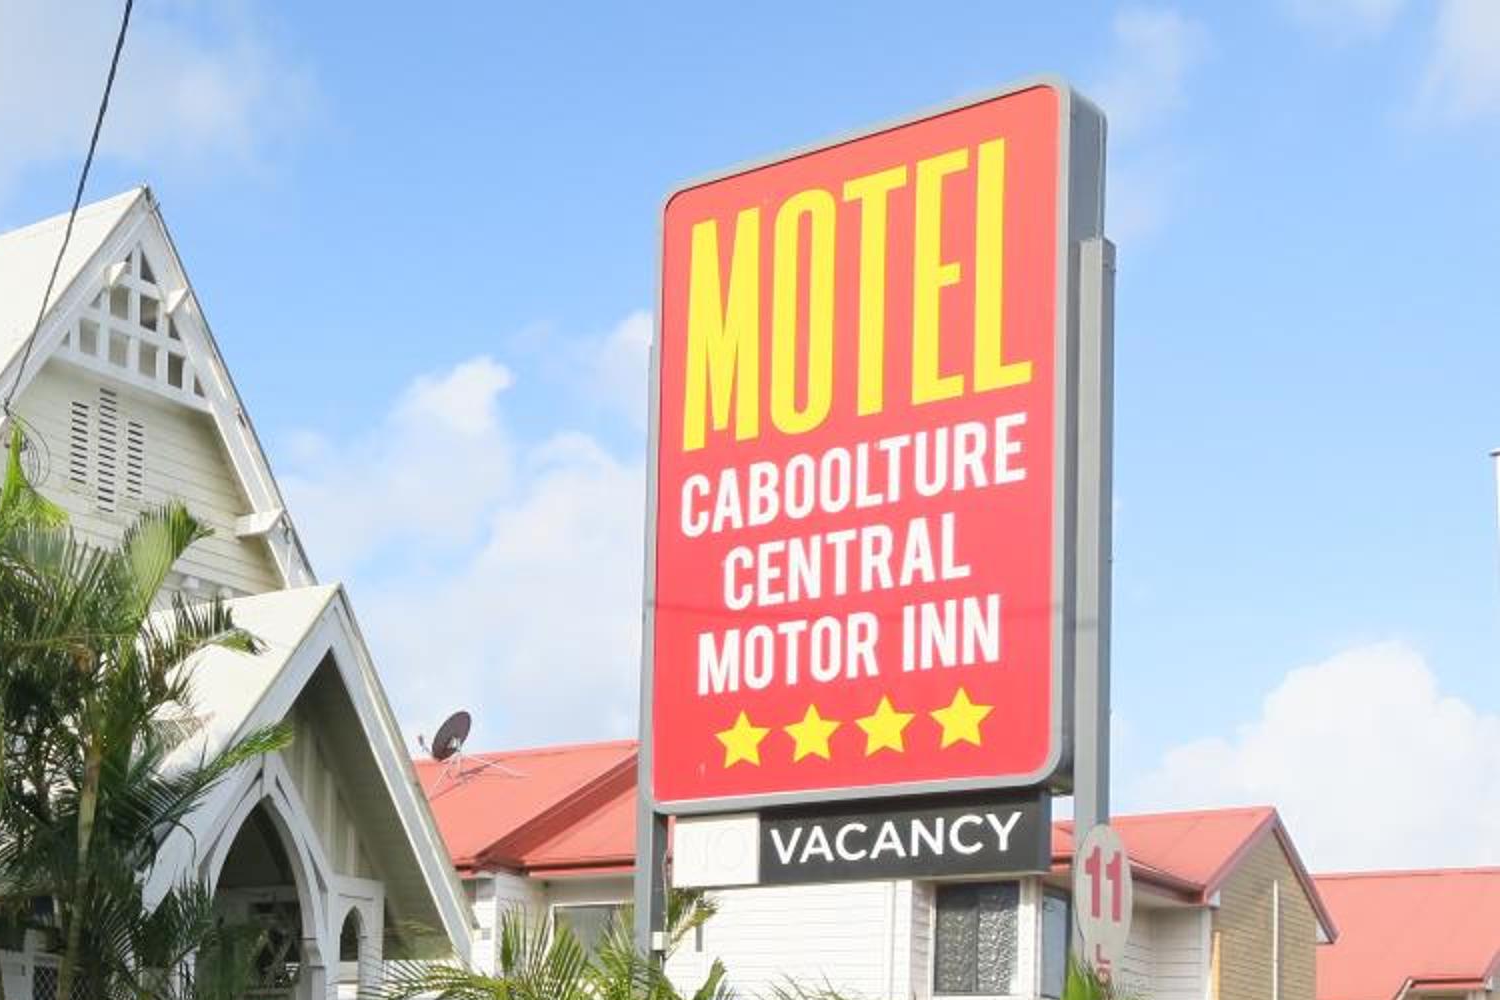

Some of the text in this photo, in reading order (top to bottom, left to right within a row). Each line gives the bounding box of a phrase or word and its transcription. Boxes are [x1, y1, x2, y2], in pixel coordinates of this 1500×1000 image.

[683, 138, 1032, 452] MOTEL
[680, 412, 1027, 538] CABOOLTURE
[723, 512, 971, 611] CENTRAL
[698, 594, 1001, 695] MOTOR INN
[769, 811, 1023, 865] VACANCY
[1084, 845, 1122, 923] 11
